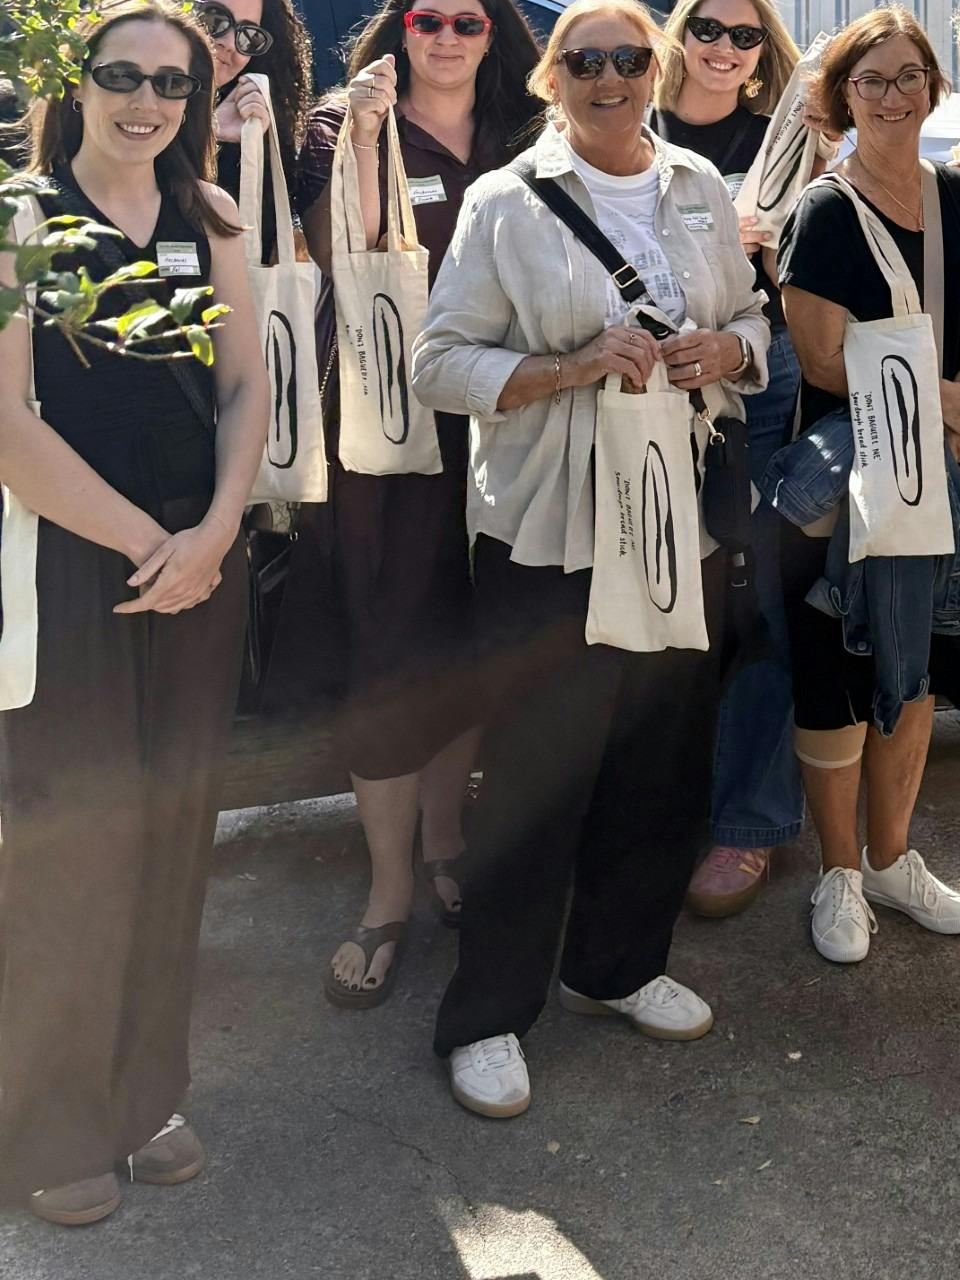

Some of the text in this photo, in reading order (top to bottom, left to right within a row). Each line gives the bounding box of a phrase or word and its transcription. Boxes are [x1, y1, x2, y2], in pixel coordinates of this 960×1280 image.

[850, 391, 869, 469] Sourdough bread stick
[867, 415, 879, 445] BAGUETTE
